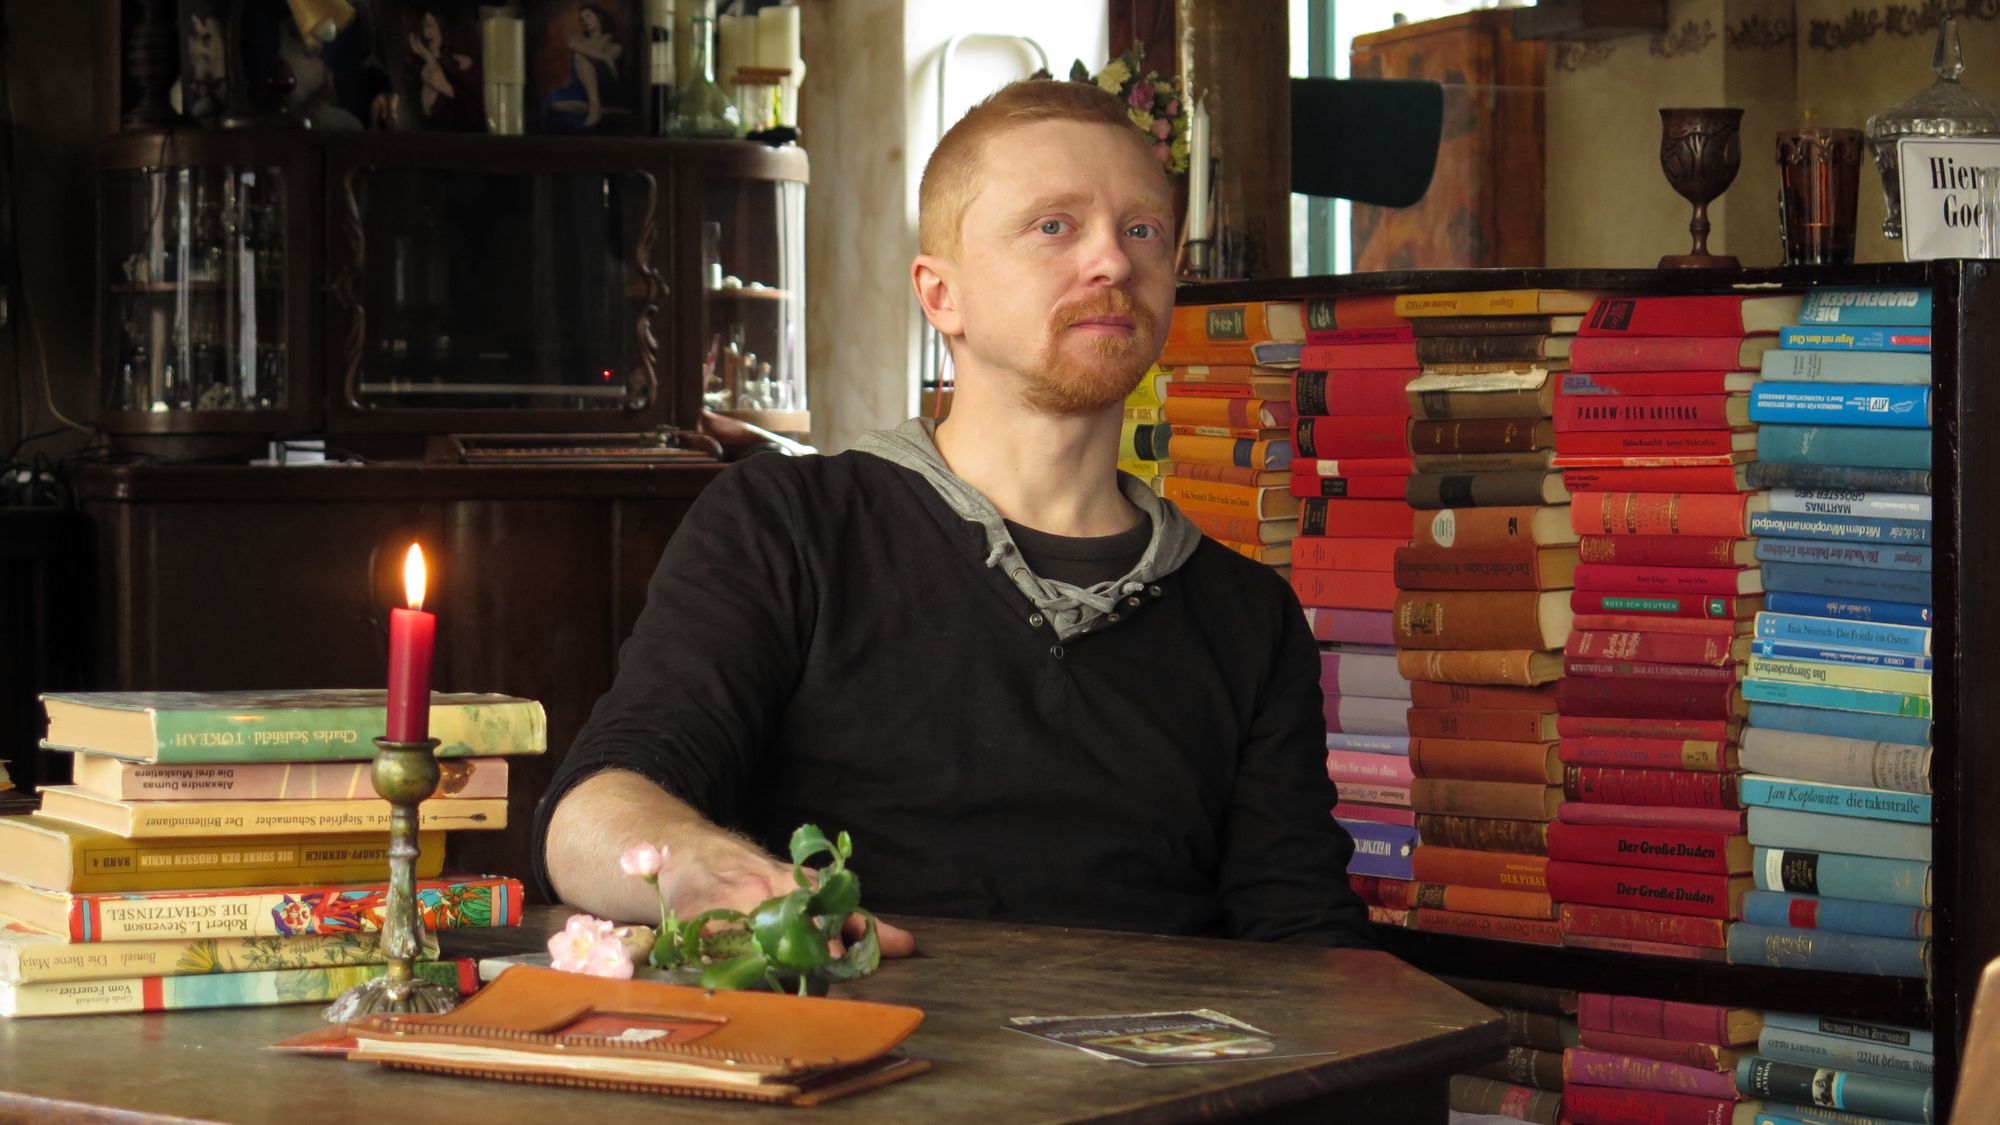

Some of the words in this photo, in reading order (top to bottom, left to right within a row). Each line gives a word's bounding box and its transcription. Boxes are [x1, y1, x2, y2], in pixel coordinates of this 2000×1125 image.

[1929, 156, 1979, 190] Hier
[1816, 306, 1841, 322] DIE
[1789, 334, 1806, 346] Chef
[1624, 406, 1645, 420] DER
[1650, 406, 1697, 420] AUFTRAG
[1794, 487, 1815, 499] SIEG
[1805, 501, 1851, 515] MARTINAS
[1752, 517, 1787, 533] Nordpol
[1786, 522, 1801, 532] am
[1800, 520, 1845, 536] Mikrophon
[1845, 525, 1866, 537] dem
[1866, 526, 1881, 539] Mit
[1753, 662, 1811, 680] Sternguckerbuch
[1812, 669, 1827, 683] Das
[175, 730, 244, 748] TOKEAH
[254, 729, 310, 745] Sealsfield
[313, 729, 357, 743] Charles
[135, 769, 193, 779] Musketiere
[196, 768, 218, 778] drei
[221, 768, 234, 778] Die
[143, 781, 179, 790] Dumas
[181, 780, 234, 790] Alexandre
[1766, 785, 1786, 804] Jan
[1788, 786, 1841, 808] Koplowitz
[1846, 793, 1863, 808] die
[1864, 794, 1921, 815] taktstraße
[146, 815, 222, 828] Brillenindianer
[225, 816, 244, 827] Der
[256, 815, 317, 827] Schumacher
[319, 814, 363, 828] Siegfried
[1617, 839, 1640, 853] Der
[1640, 841, 1676, 856] Große
[1676, 842, 1716, 860] Duden
[92, 856, 100, 868] 4
[103, 855, 132, 868] BAND
[174, 852, 219, 865] GROSSEN
[221, 851, 241, 865] DER
[276, 850, 294, 863] DIE
[306, 850, 387, 863] LSKOPF-HENRICH
[1500, 873, 1517, 884] DER
[1616, 882, 1638, 896] Der
[1639, 884, 1675, 900] Große
[1675, 887, 1715, 904] Duden
[106, 904, 225, 921] SCHATZINSEL
[228, 903, 249, 916] DIE
[221, 919, 249, 931] Robert
[54, 955, 85, 968] Biene
[87, 954, 108, 966] Die
[120, 951, 157, 965] Bonsels
[113, 984, 133, 995] Vom
[1767, 1038, 1790, 1049] OTTO
[1790, 1043, 1828, 1057] LINDNER
